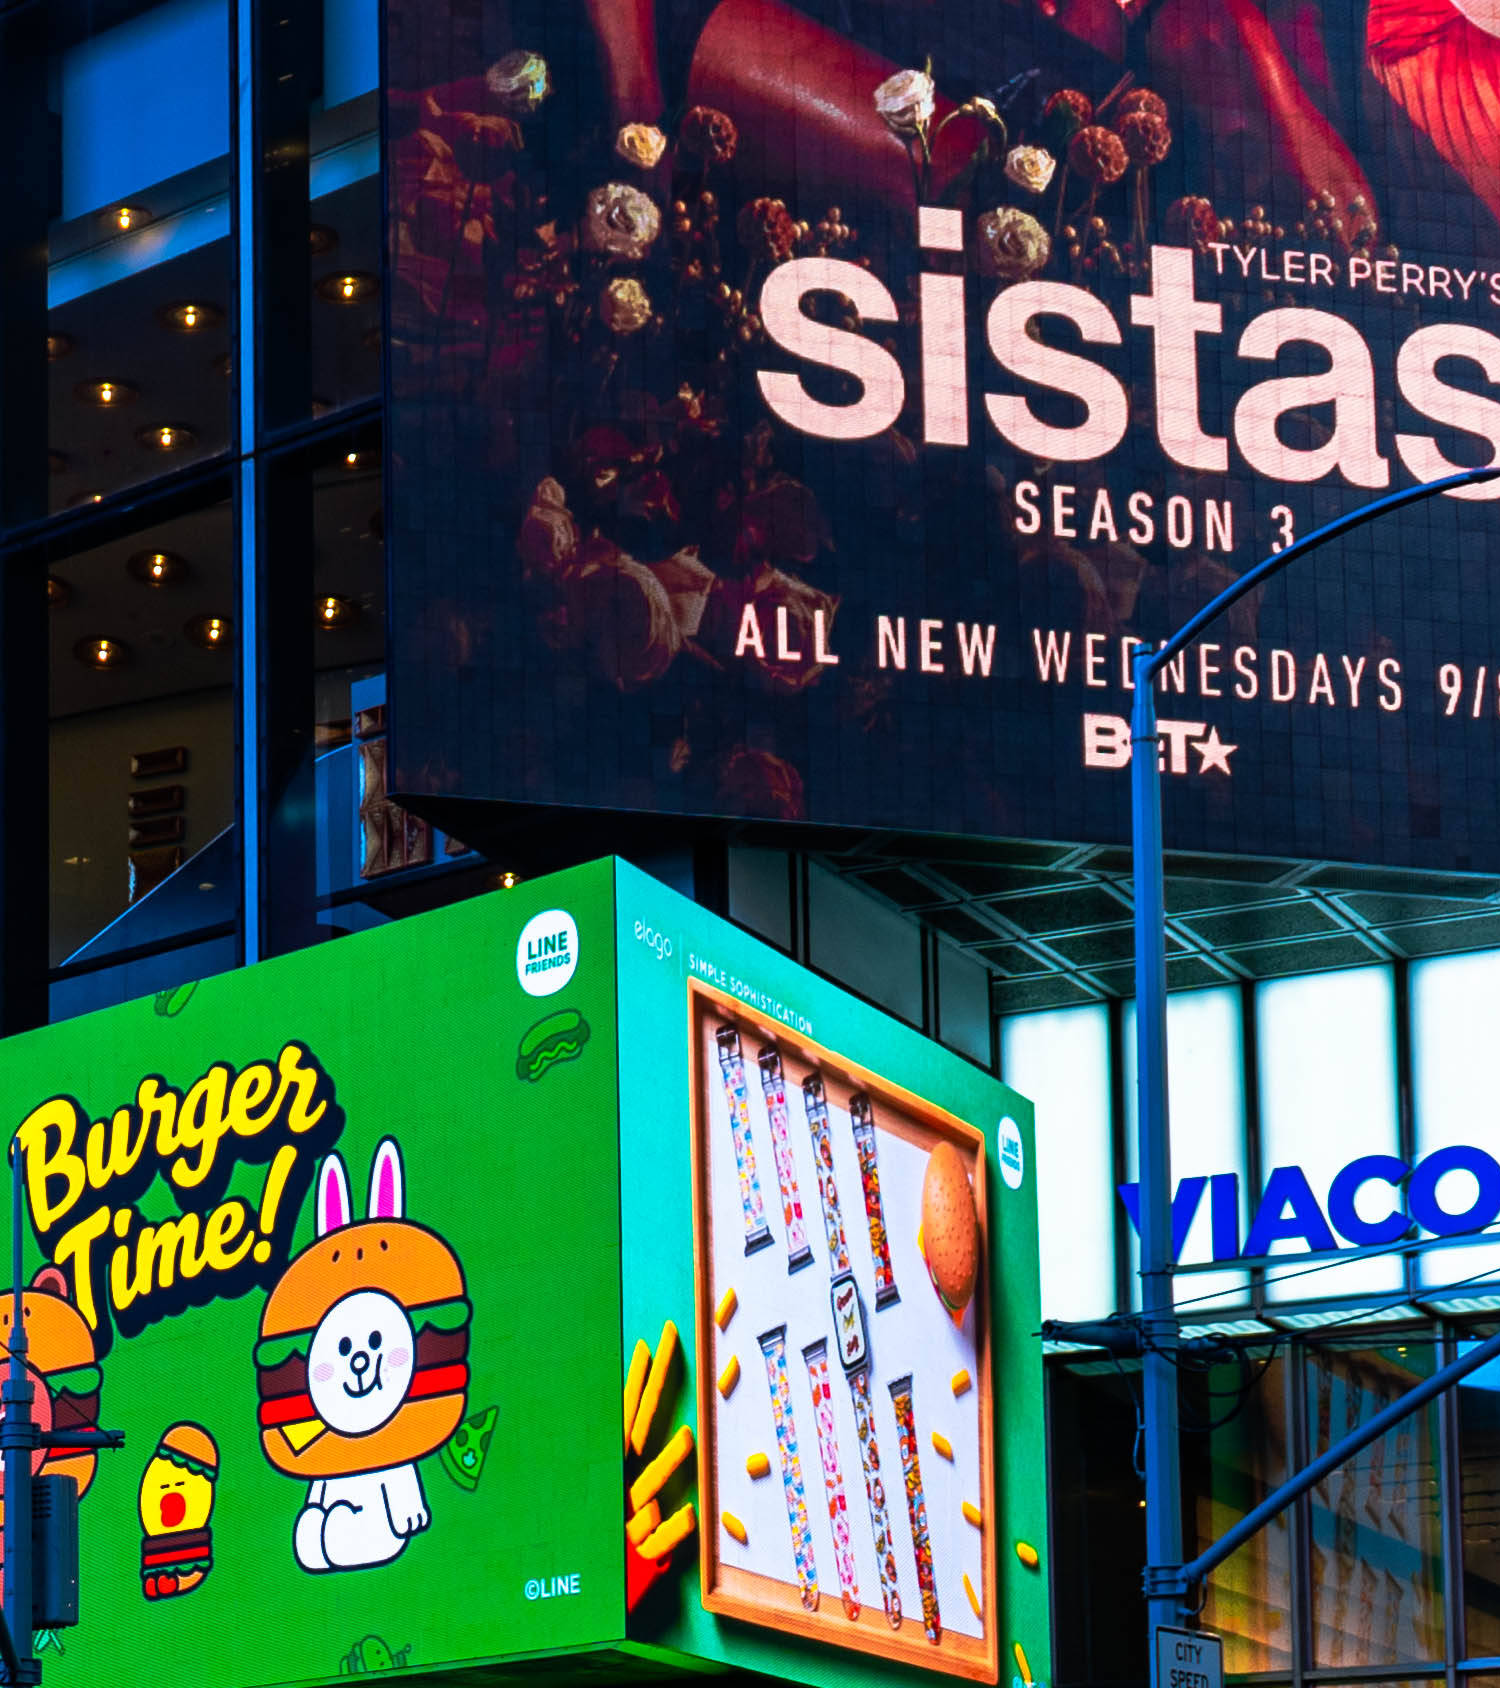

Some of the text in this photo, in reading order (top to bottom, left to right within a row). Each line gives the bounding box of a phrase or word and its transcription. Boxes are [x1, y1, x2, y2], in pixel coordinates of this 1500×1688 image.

[1209, 242, 1334, 286] TYLER
[1016, 480, 1295, 555] SEASON 3
[734, 605, 839, 664] ALL
[876, 615, 996, 677] NEW
[1033, 628, 1402, 711] WEDNESDAYS
[1083, 713, 1207, 774] BT
[524, 952, 572, 977] FRIENDS
[527, 929, 569, 960] LINE
[633, 919, 673, 961] elago
[688, 953, 813, 1037] SIMPLE SOPHISTICATION
[13, 1043, 327, 1232] Burger
[50, 1144, 297, 1332] Time!
[1175, 1642, 1202, 1665] CITY
